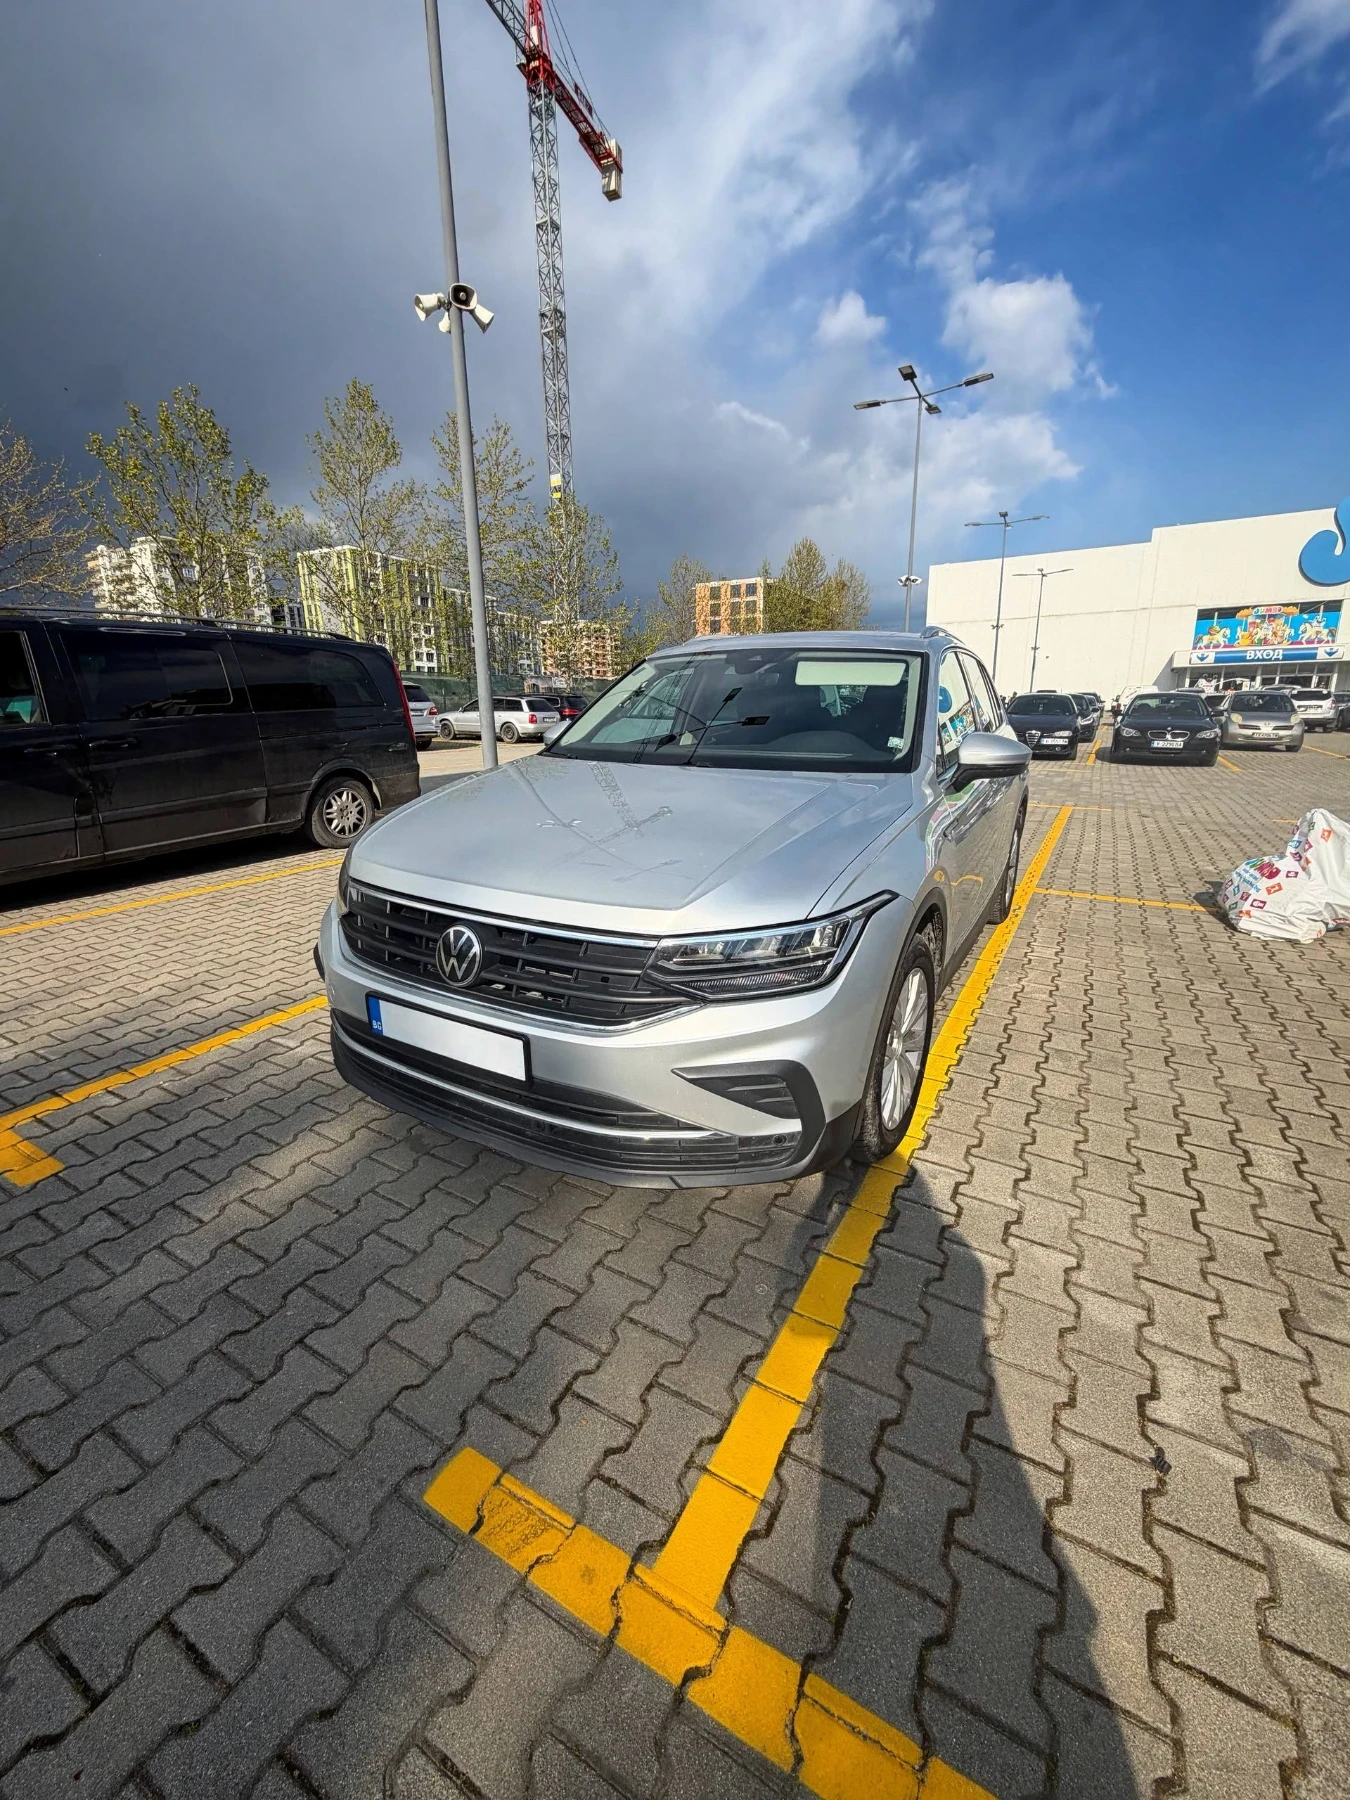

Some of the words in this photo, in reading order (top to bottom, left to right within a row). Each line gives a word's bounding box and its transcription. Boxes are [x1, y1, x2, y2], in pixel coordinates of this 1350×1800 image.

[1246, 650, 1283, 661] ВХОД
[438, 926, 480, 983] VW
[372, 1019, 382, 1031] BG
